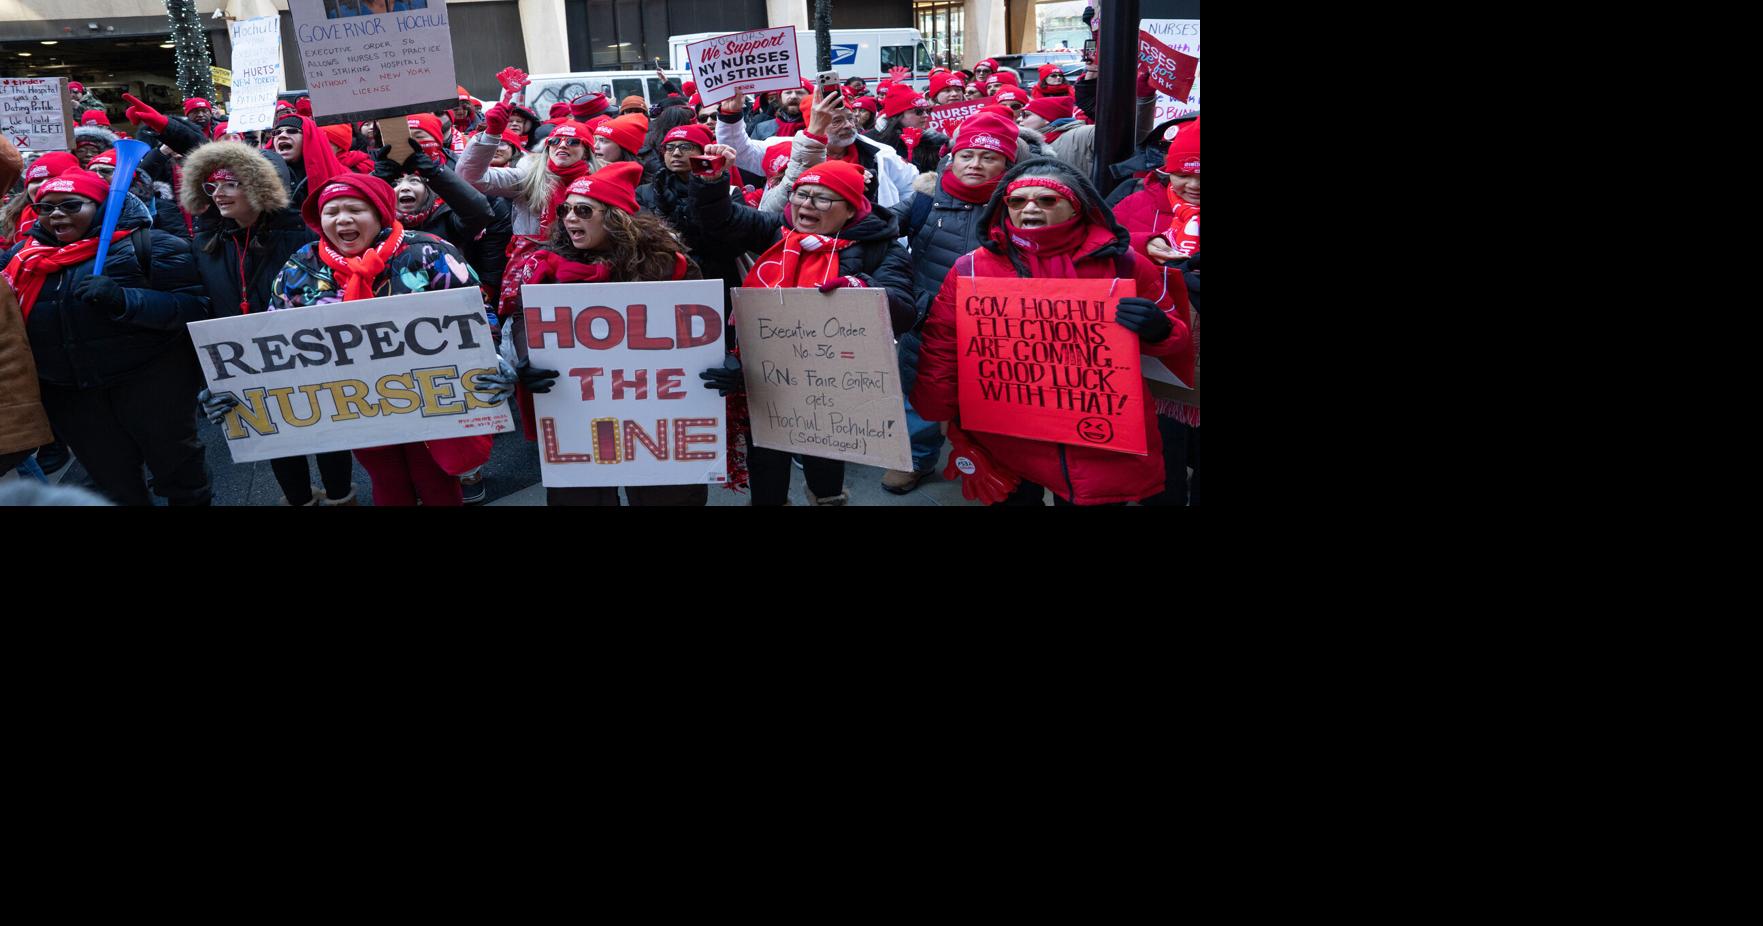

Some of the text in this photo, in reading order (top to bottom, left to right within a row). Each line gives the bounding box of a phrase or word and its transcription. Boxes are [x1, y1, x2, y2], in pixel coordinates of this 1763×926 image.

[233, 18, 278, 38] Hochul!
[300, 13, 446, 44] GOVERNOR HOCHUL
[1149, 23, 1198, 36] NURSES
[304, 46, 351, 58] EXECUTIVE
[363, 40, 391, 50] ORDER
[307, 45, 441, 68] ALLOWS NURSES TO PRACTICE
[701, 32, 785, 63] We Support
[1140, 40, 1177, 71] RSES
[244, 64, 275, 78] HURTS
[309, 57, 426, 79] IN STRIKING HOSPITALS
[699, 50, 790, 77] NY NURSES
[704, 63, 789, 89] ON STRIKE
[311, 79, 348, 90] WITHOUT
[379, 71, 400, 81] NEW
[406, 68, 432, 76] YORK
[352, 84, 392, 96] LICENSE
[4, 102, 30, 114] Dating
[10, 116, 22, 125] We
[34, 124, 61, 134] LEFT
[965, 296, 1114, 323] GOV. HOCHUL
[524, 304, 722, 350] HOLD
[758, 318, 816, 340] Executive
[977, 318, 1107, 344] ELECTIONS
[199, 312, 487, 382] RESPECT
[816, 344, 835, 359] 56
[965, 336, 1011, 360] ARE
[568, 368, 688, 401] THE
[762, 360, 798, 386] RNs
[978, 359, 1117, 394] GOOD LUCK
[213, 365, 505, 440] NURSES
[804, 394, 834, 410] gets
[978, 380, 1128, 416] WITH THAT!
[540, 417, 718, 464] LINE
